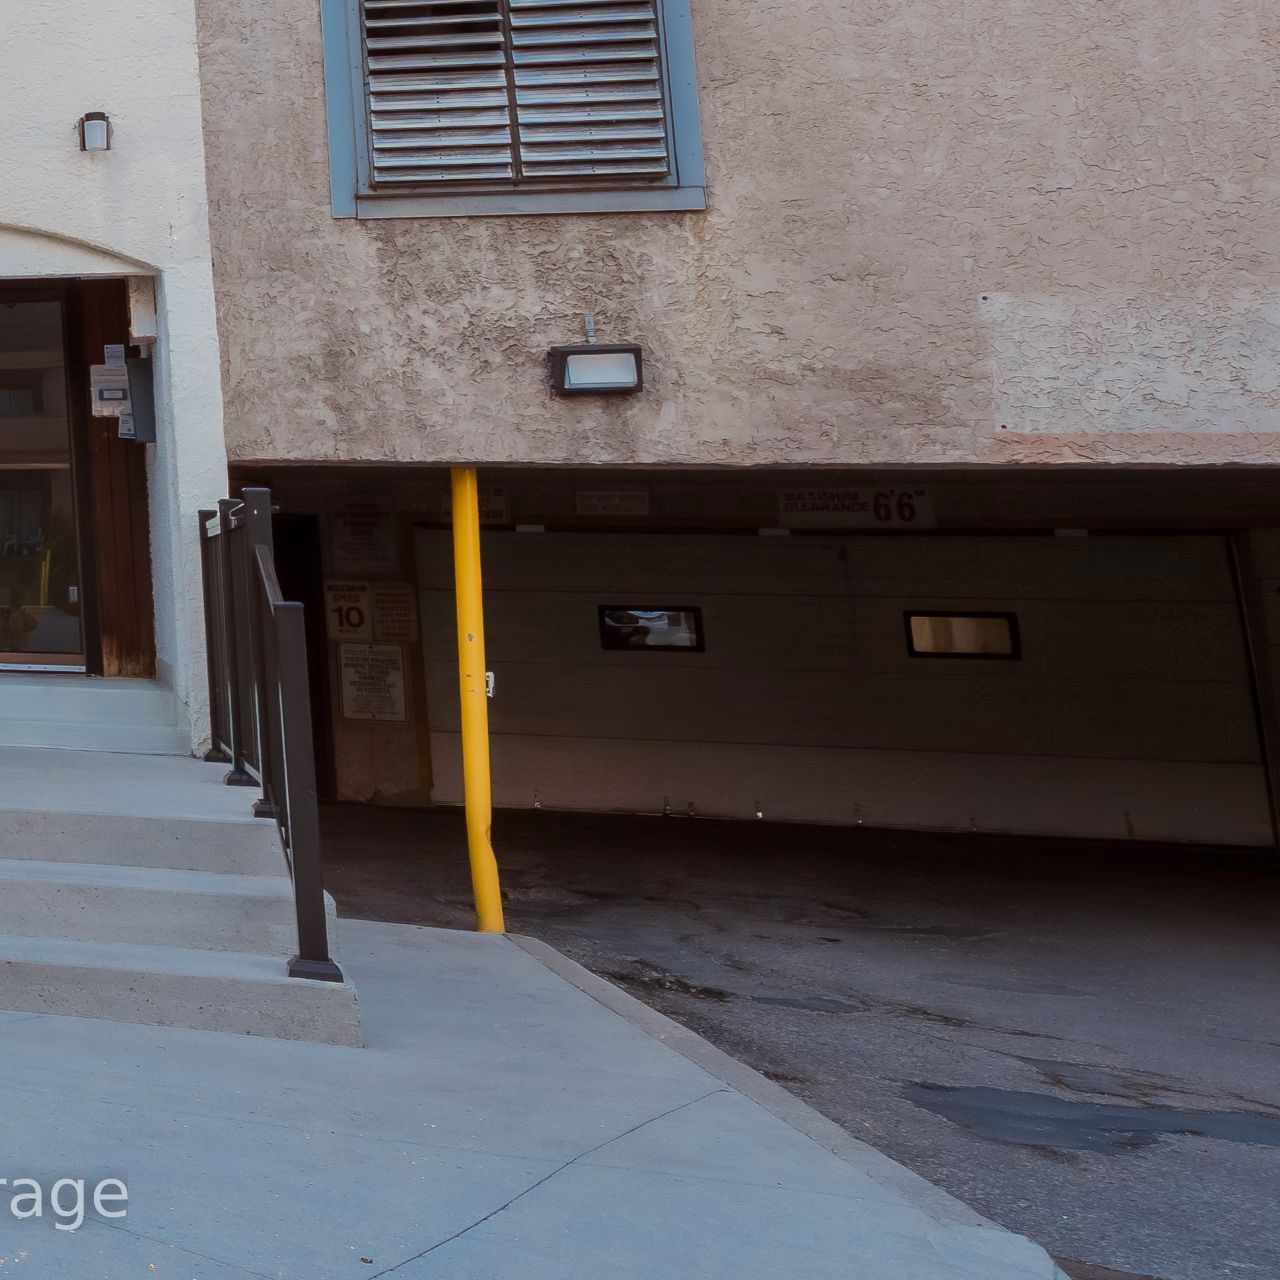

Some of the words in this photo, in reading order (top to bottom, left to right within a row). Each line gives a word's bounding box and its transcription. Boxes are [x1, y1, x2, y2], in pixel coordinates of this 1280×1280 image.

[784, 490, 858, 502] MAXIMUM
[784, 502, 868, 512] CLEARANCE
[331, 606, 365, 628] 10
